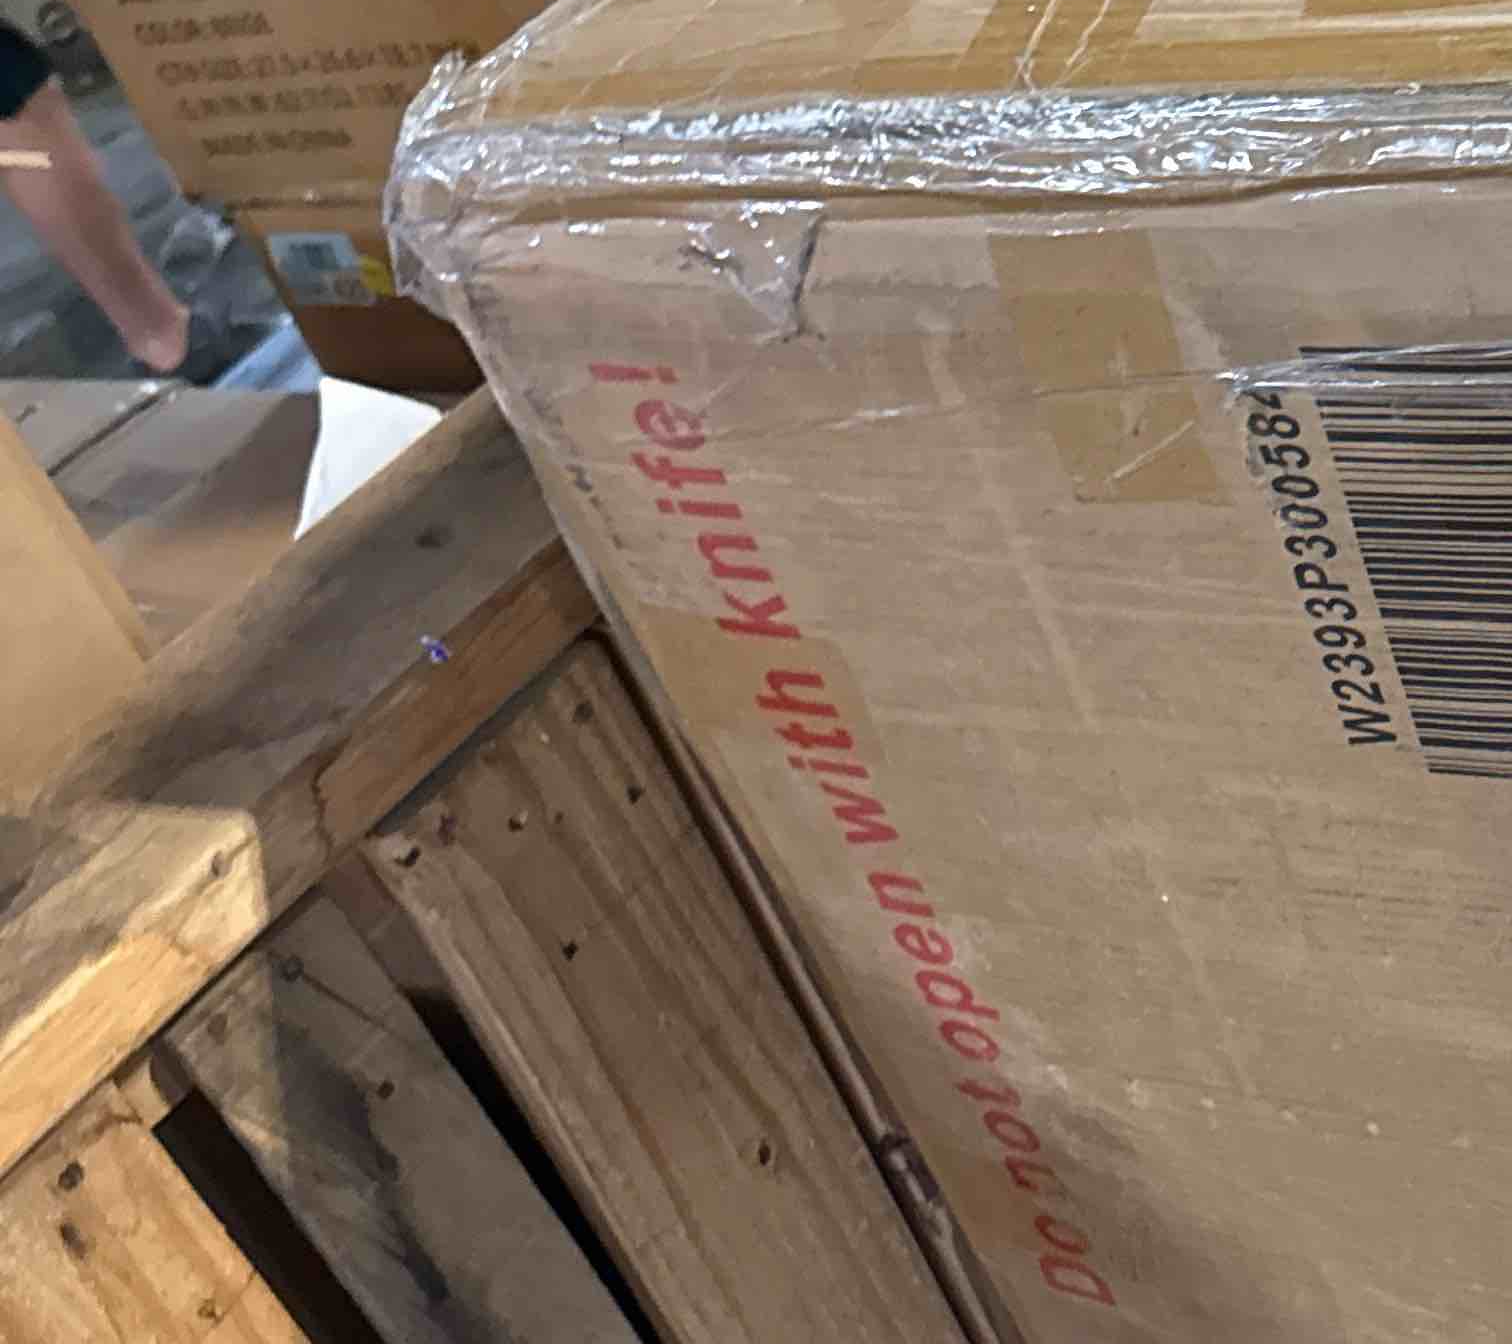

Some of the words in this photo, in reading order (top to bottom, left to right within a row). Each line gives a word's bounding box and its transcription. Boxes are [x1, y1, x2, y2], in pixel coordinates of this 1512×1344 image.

[588, 362, 800, 644] knife!
[755, 665, 900, 848] with
[868, 869, 1003, 1063] open
[955, 1076, 1068, 1191] not
[1040, 1211, 1117, 1308] Do
